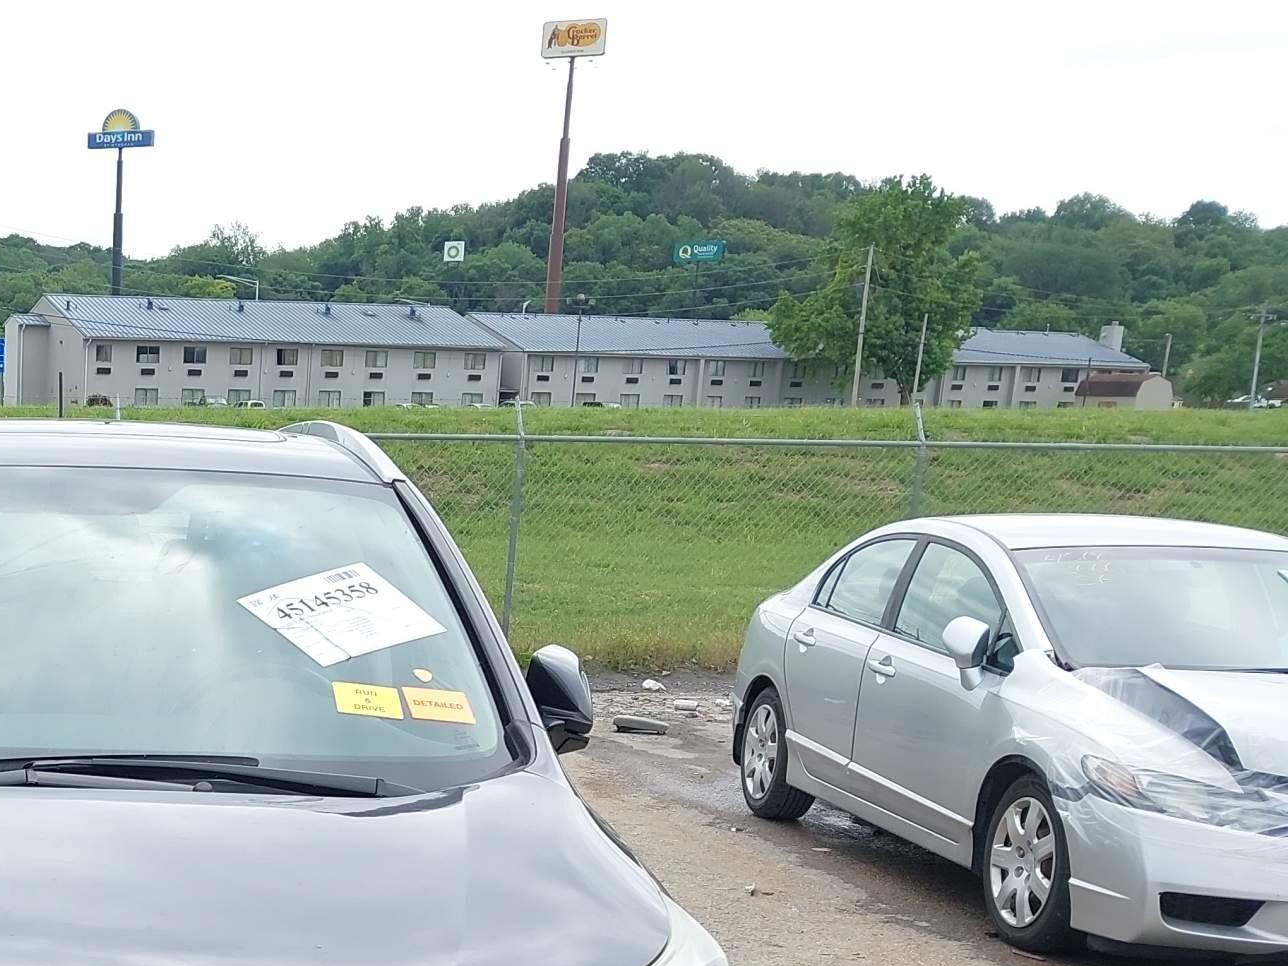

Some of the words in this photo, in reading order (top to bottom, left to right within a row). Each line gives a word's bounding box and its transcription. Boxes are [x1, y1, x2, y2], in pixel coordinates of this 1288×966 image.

[96, 133, 123, 143] Days
[124, 132, 142, 141] Inn
[693, 244, 718, 254] Quality
[277, 582, 378, 619] 45145358
[353, 703, 386, 713] DRIVE
[412, 699, 464, 710] DETAILED
